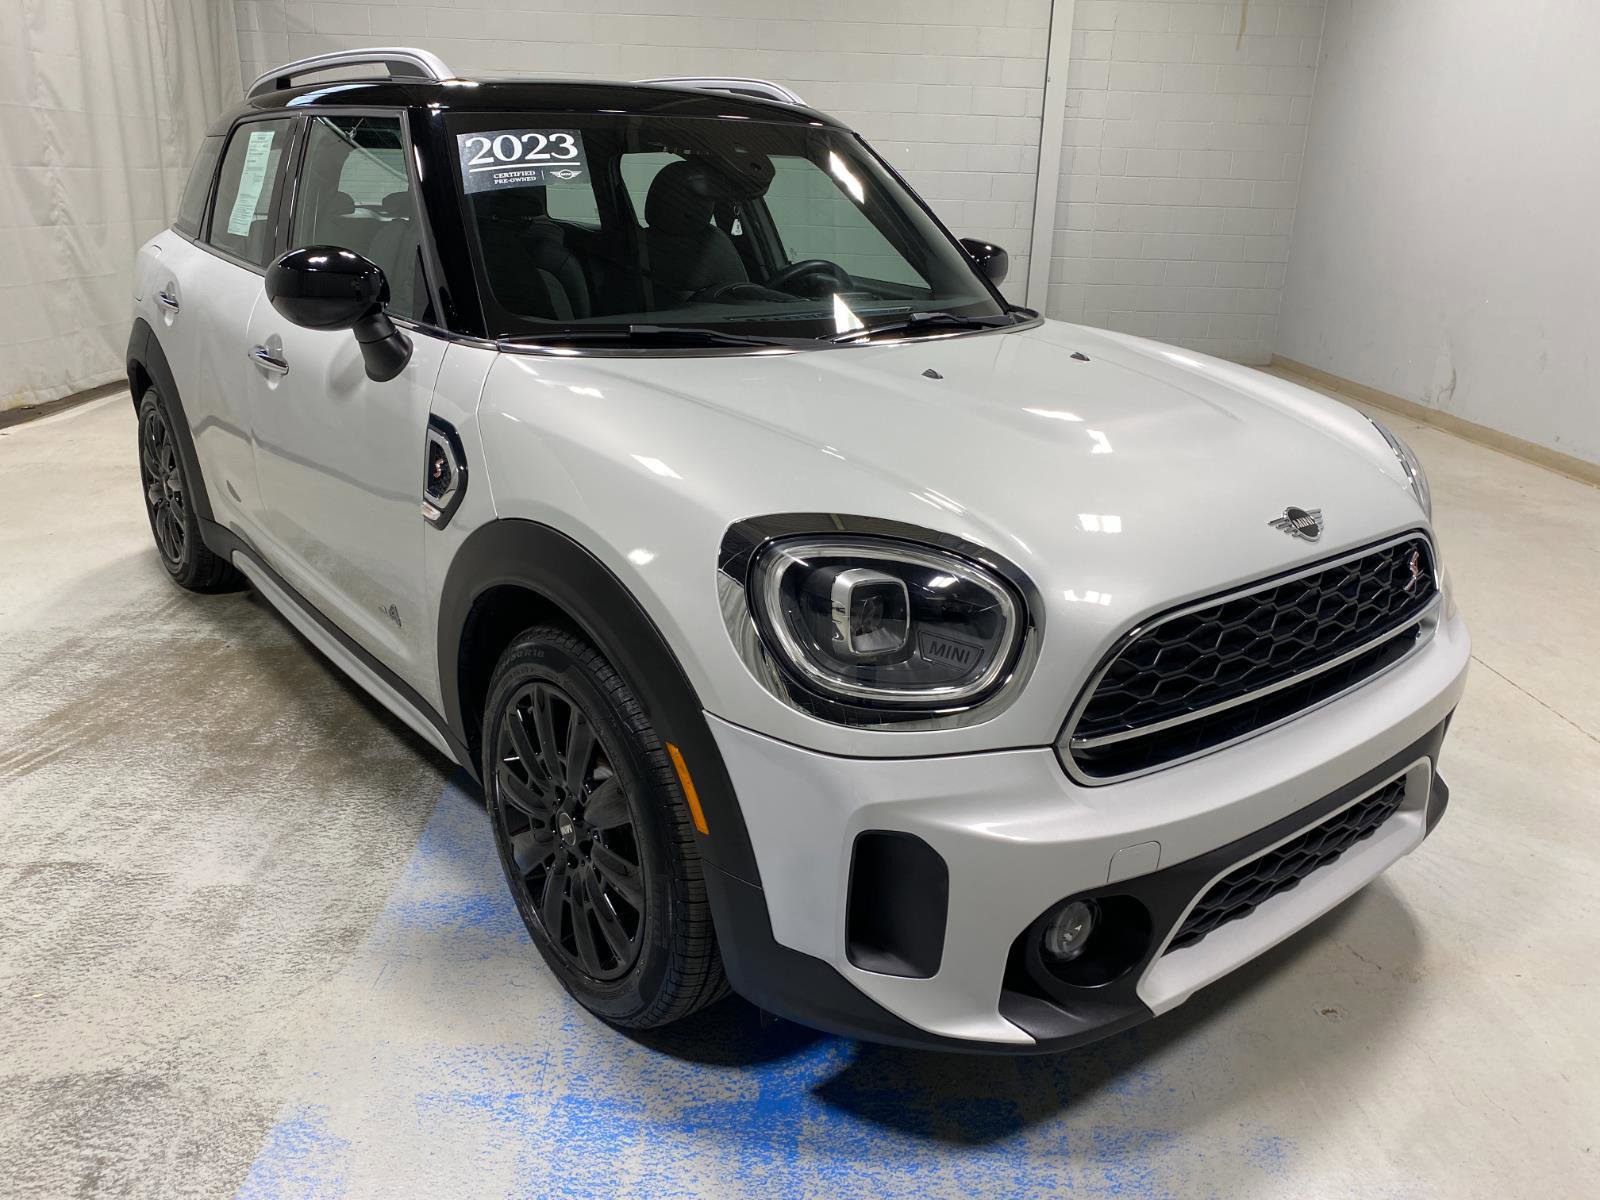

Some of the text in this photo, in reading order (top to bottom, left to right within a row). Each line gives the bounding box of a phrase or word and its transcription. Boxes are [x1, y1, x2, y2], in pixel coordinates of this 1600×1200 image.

[465, 133, 578, 165] 2023
[493, 170, 536, 179] CERTIFIED
[493, 176, 537, 185] PRE-OWNED
[928, 640, 971, 664] MINI
